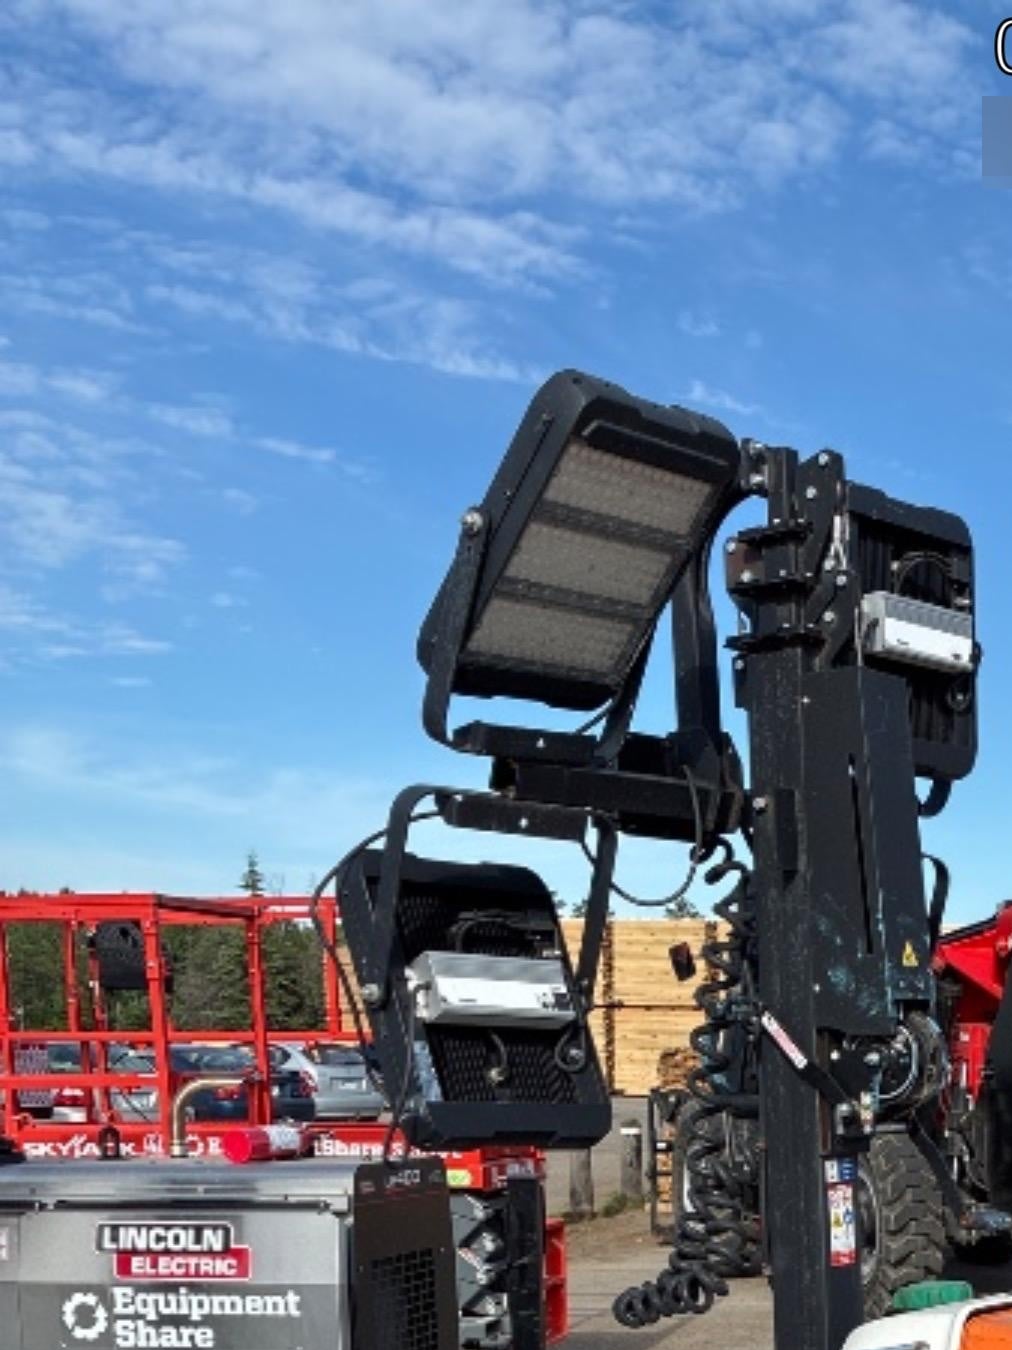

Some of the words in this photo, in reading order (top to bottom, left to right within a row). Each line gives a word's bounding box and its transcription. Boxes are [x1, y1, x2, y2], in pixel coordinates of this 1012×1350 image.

[22, 1135, 135, 1158] SKYJAK
[103, 1226, 224, 1251] LINCOLN
[131, 1256, 237, 1275] ELECTRIC
[112, 1287, 301, 1321] Equipment
[114, 1319, 214, 1348] Share
